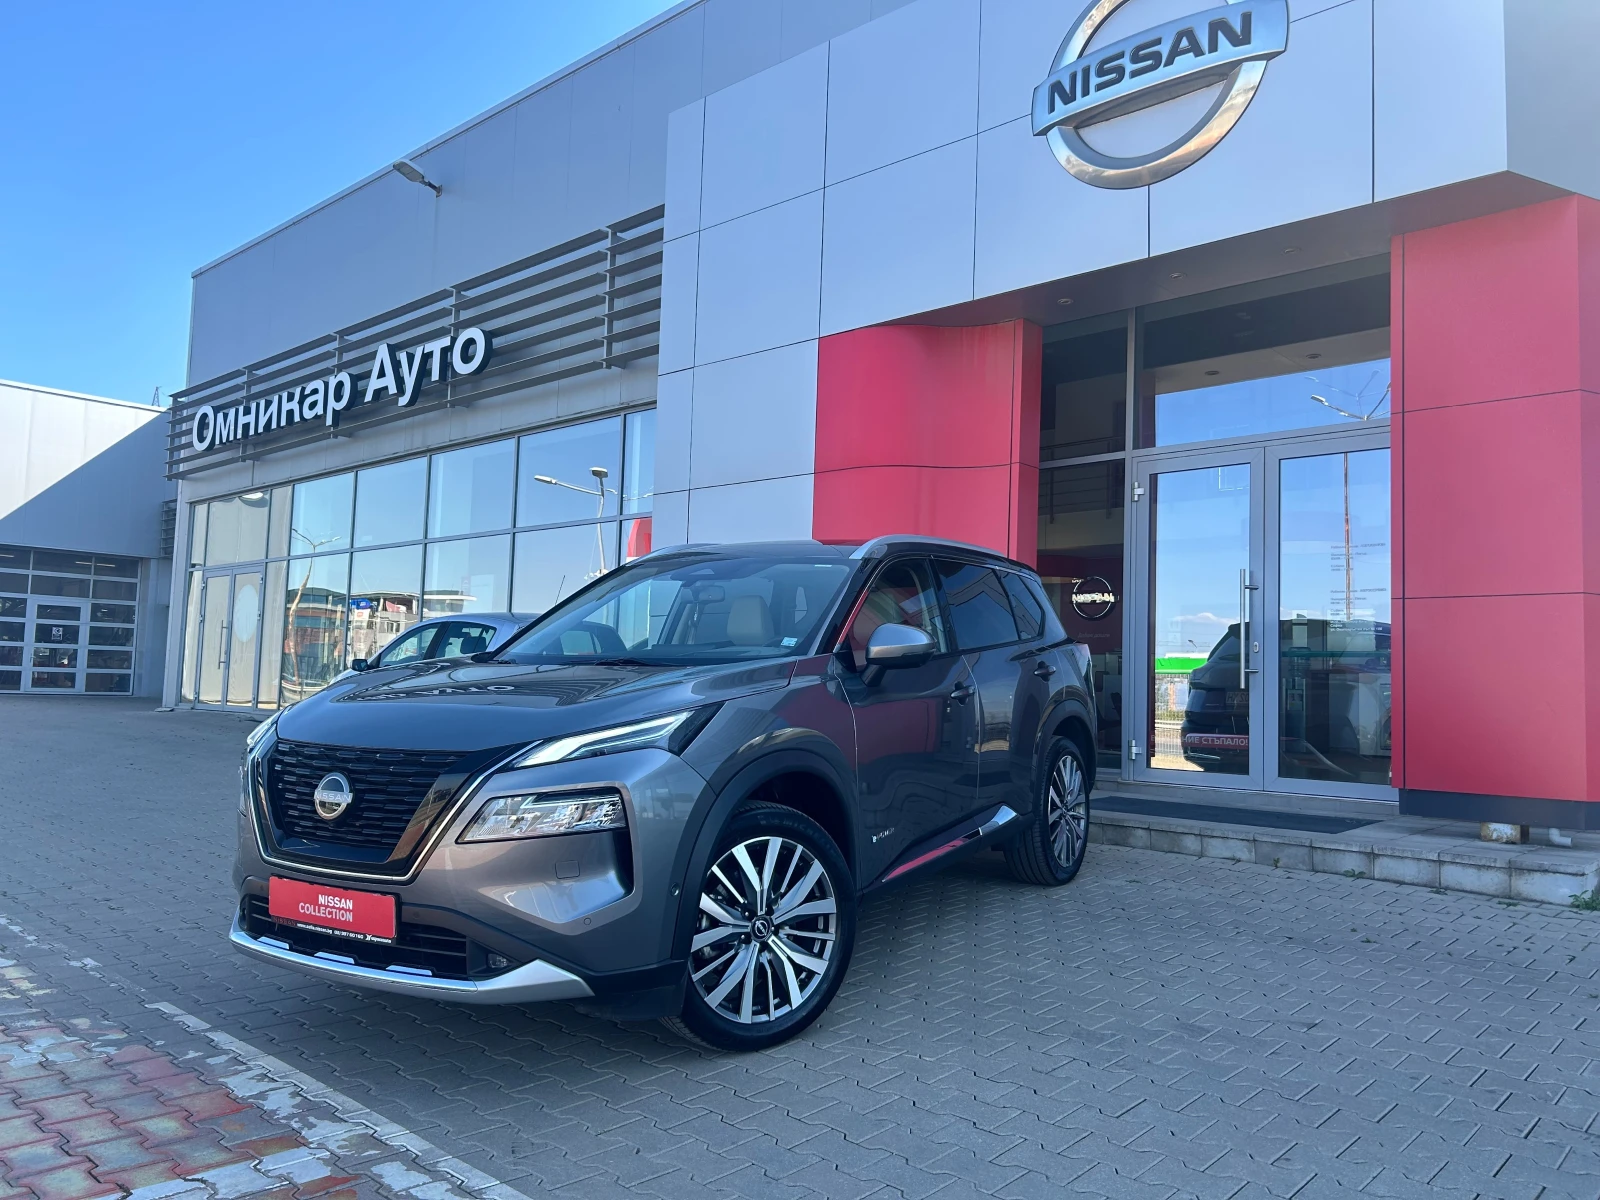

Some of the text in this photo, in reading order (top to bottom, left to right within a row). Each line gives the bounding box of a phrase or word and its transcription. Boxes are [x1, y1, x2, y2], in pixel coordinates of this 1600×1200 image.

[1047, 11, 1252, 115] NISSAN
[192, 327, 487, 451] Омникар Ауто
[1201, 736, 1249, 746] СТЪПАЛО!
[298, 902, 353, 922] COLLECTION
[318, 894, 353, 910] NISSAN
